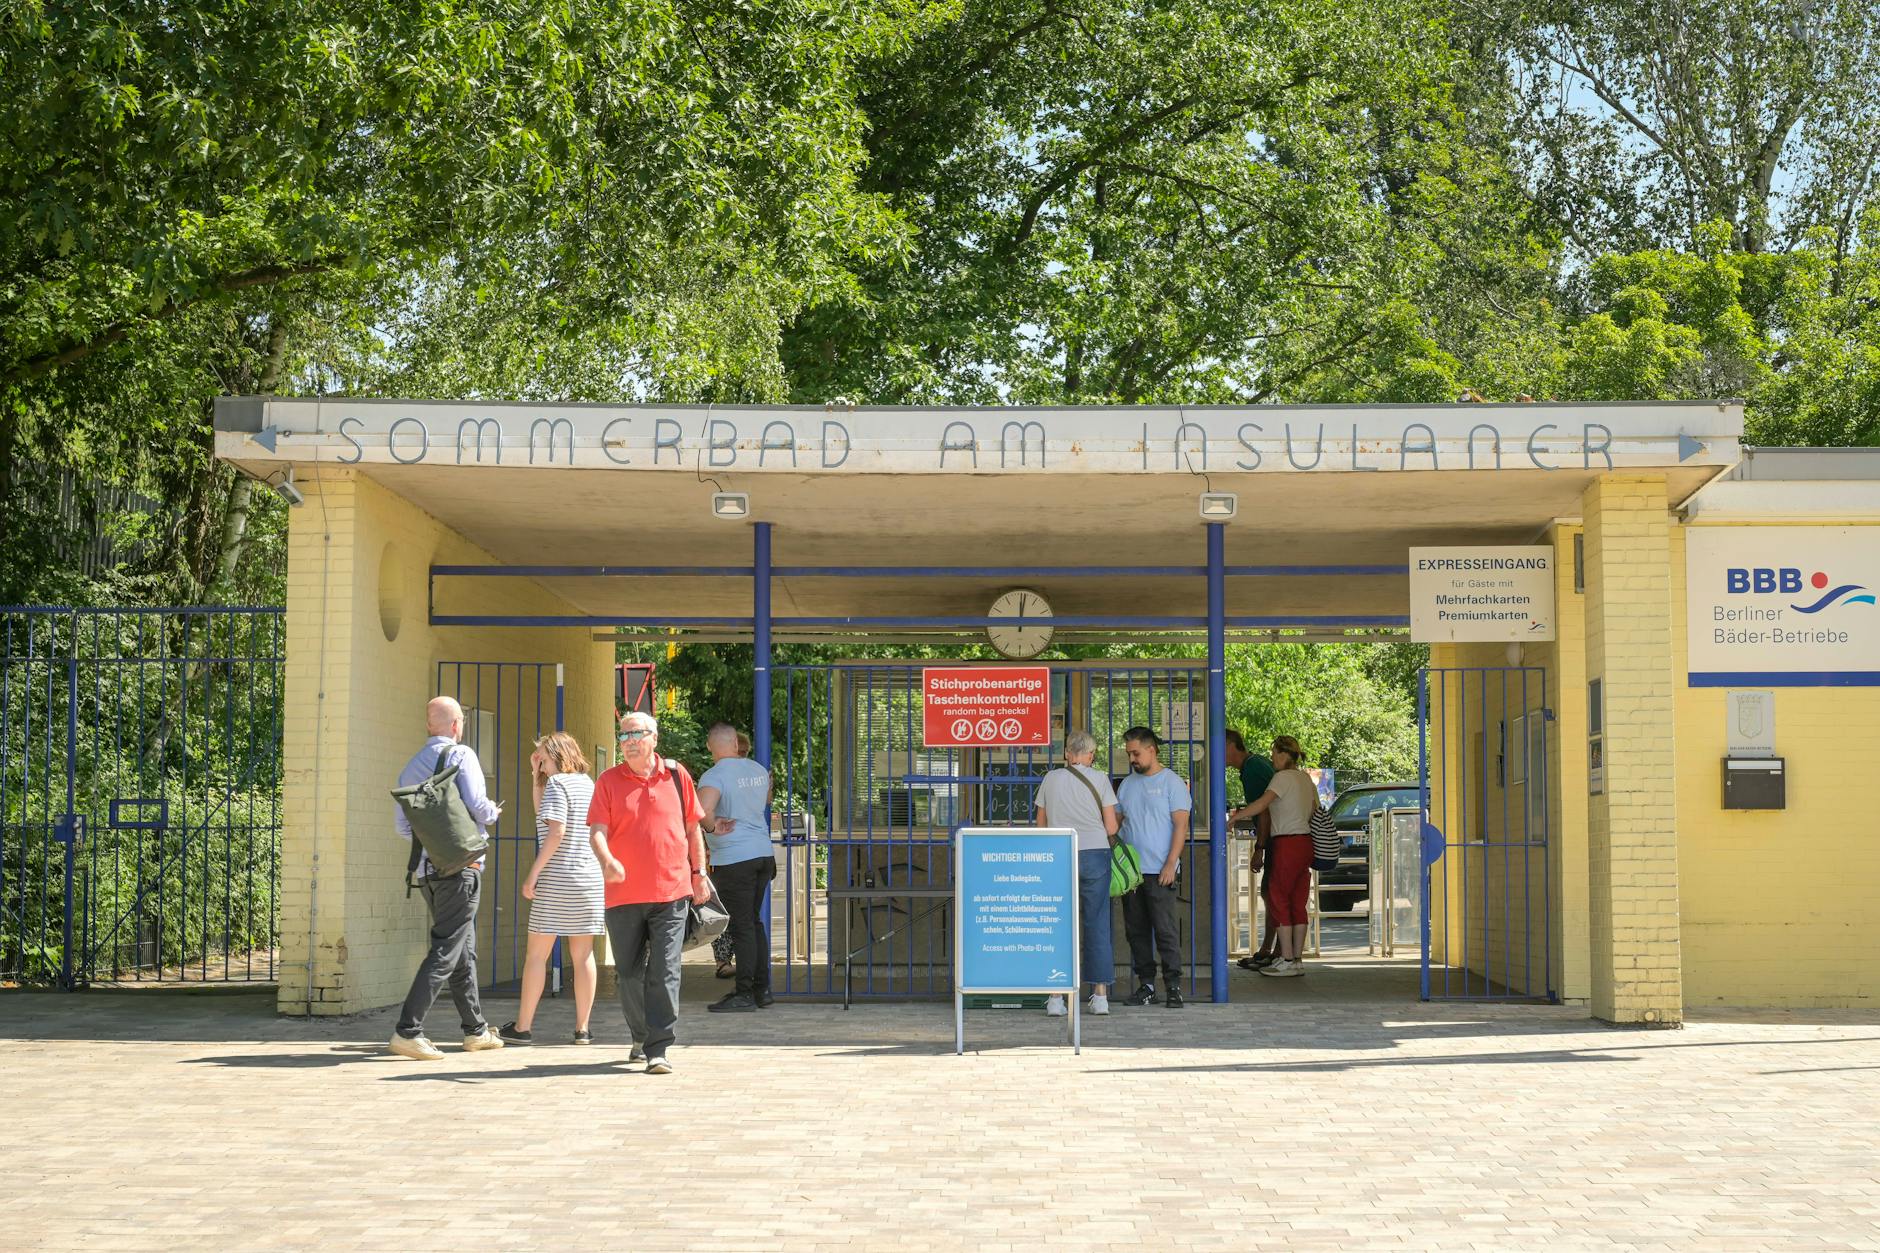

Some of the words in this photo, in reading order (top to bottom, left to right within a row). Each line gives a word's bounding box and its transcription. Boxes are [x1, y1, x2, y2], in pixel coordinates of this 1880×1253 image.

[337, 417, 850, 468] SOMMERBAD
[940, 421, 1046, 469] AM
[1143, 422, 1614, 471] INSULANER
[1418, 558, 1546, 570] EXPRESSEINGANG
[1452, 579, 1464, 588] für
[1468, 579, 1495, 588] Gäste
[1498, 579, 1514, 588] mit
[1727, 568, 1803, 594] BBB
[1436, 594, 1531, 605] Mehrfachkarten
[1438, 610, 1529, 621] Premiumkarten
[1713, 605, 1783, 621] Berliner
[1714, 627, 1849, 644] Bäder-Betriebe
[930, 677, 1042, 691] Stichprobenartige
[927, 692, 1045, 705] Taschenkontrollen!
[943, 707, 976, 716] random
[979, 707, 995, 717] bag
[997, 706, 1029, 715] checks!
[982, 852, 1022, 863] WICHTIGER
[1023, 852, 1054, 863] HINWEIS
[993, 874, 1009, 882] Liebe
[982, 894, 1000, 902] sofort
[1000, 894, 1020, 903] erfolgt
[1021, 894, 1031, 902] der
[1031, 894, 1052, 902] Einlass
[1009, 904, 1057, 912] Lichtbildausweis
[982, 944, 1003, 952] Access
[1004, 944, 1017, 952] with
[1042, 944, 1055, 953] only
